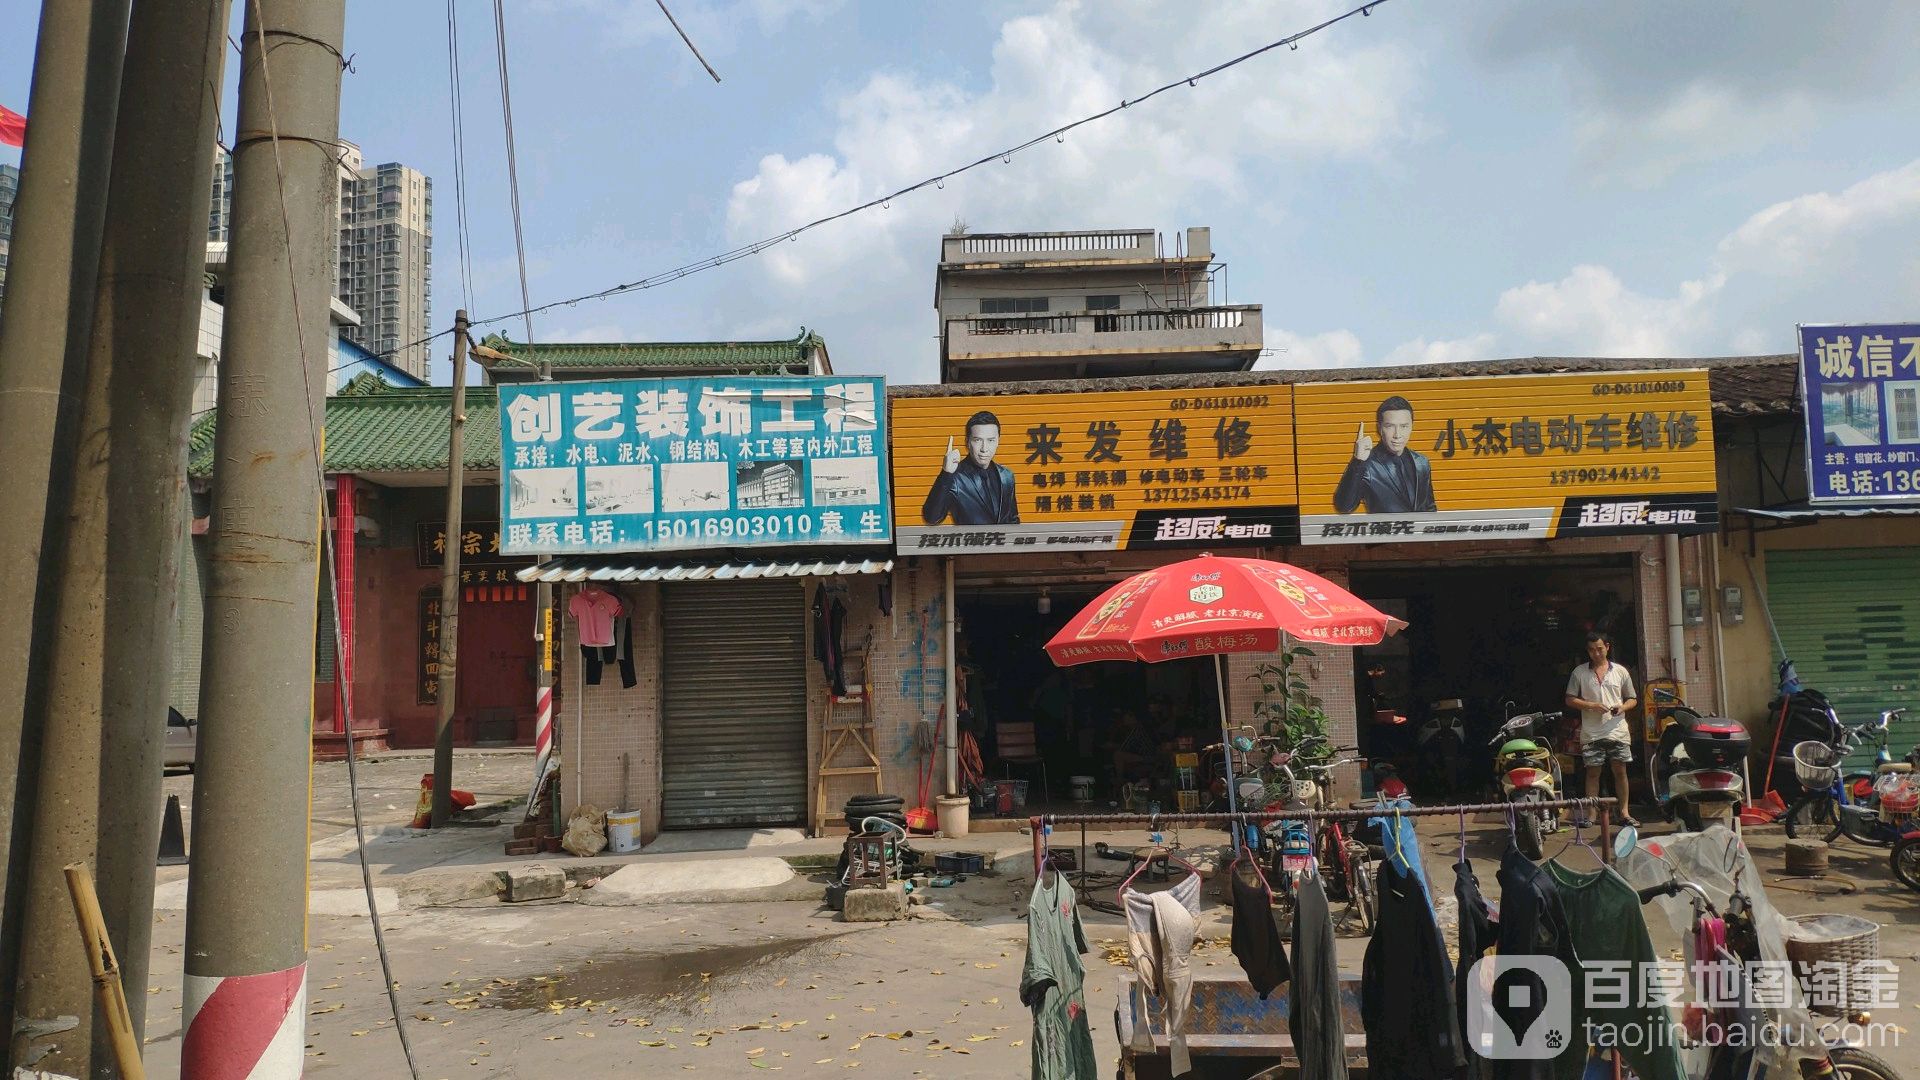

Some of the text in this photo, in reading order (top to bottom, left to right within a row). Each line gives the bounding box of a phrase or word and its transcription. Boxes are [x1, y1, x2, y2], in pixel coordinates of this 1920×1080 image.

[506, 383, 877, 442] 创艺装饰工程
[1434, 411, 1700, 457] 小杰电动车维修
[1025, 416, 1253, 466] 来发维修
[643, 514, 812, 539] 15016903010
[1194, 633, 1258, 650] 酸梅汤
